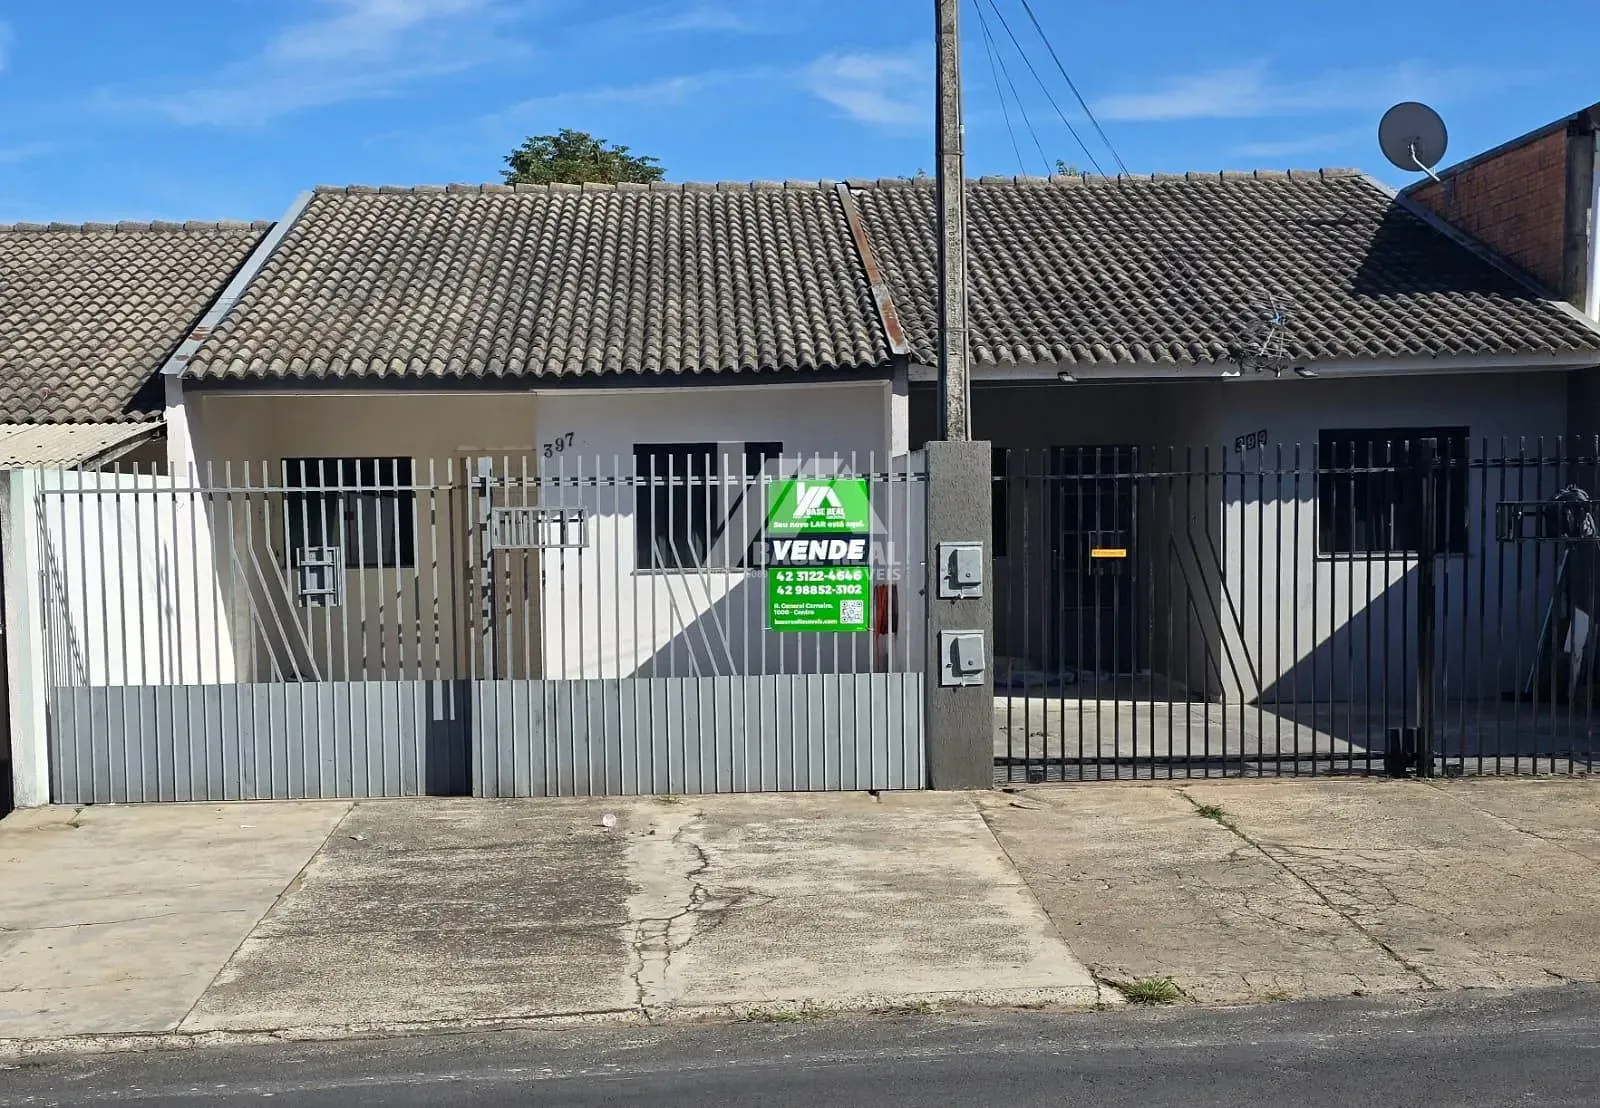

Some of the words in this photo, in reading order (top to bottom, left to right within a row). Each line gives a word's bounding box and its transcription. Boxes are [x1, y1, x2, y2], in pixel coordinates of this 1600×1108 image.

[543, 432, 574, 458] 397
[772, 539, 866, 561] VENDE
[776, 571, 794, 582] 42
[796, 570, 862, 582] 3122-4646
[776, 586, 793, 595] 42
[795, 584, 862, 595] 98852-3102
